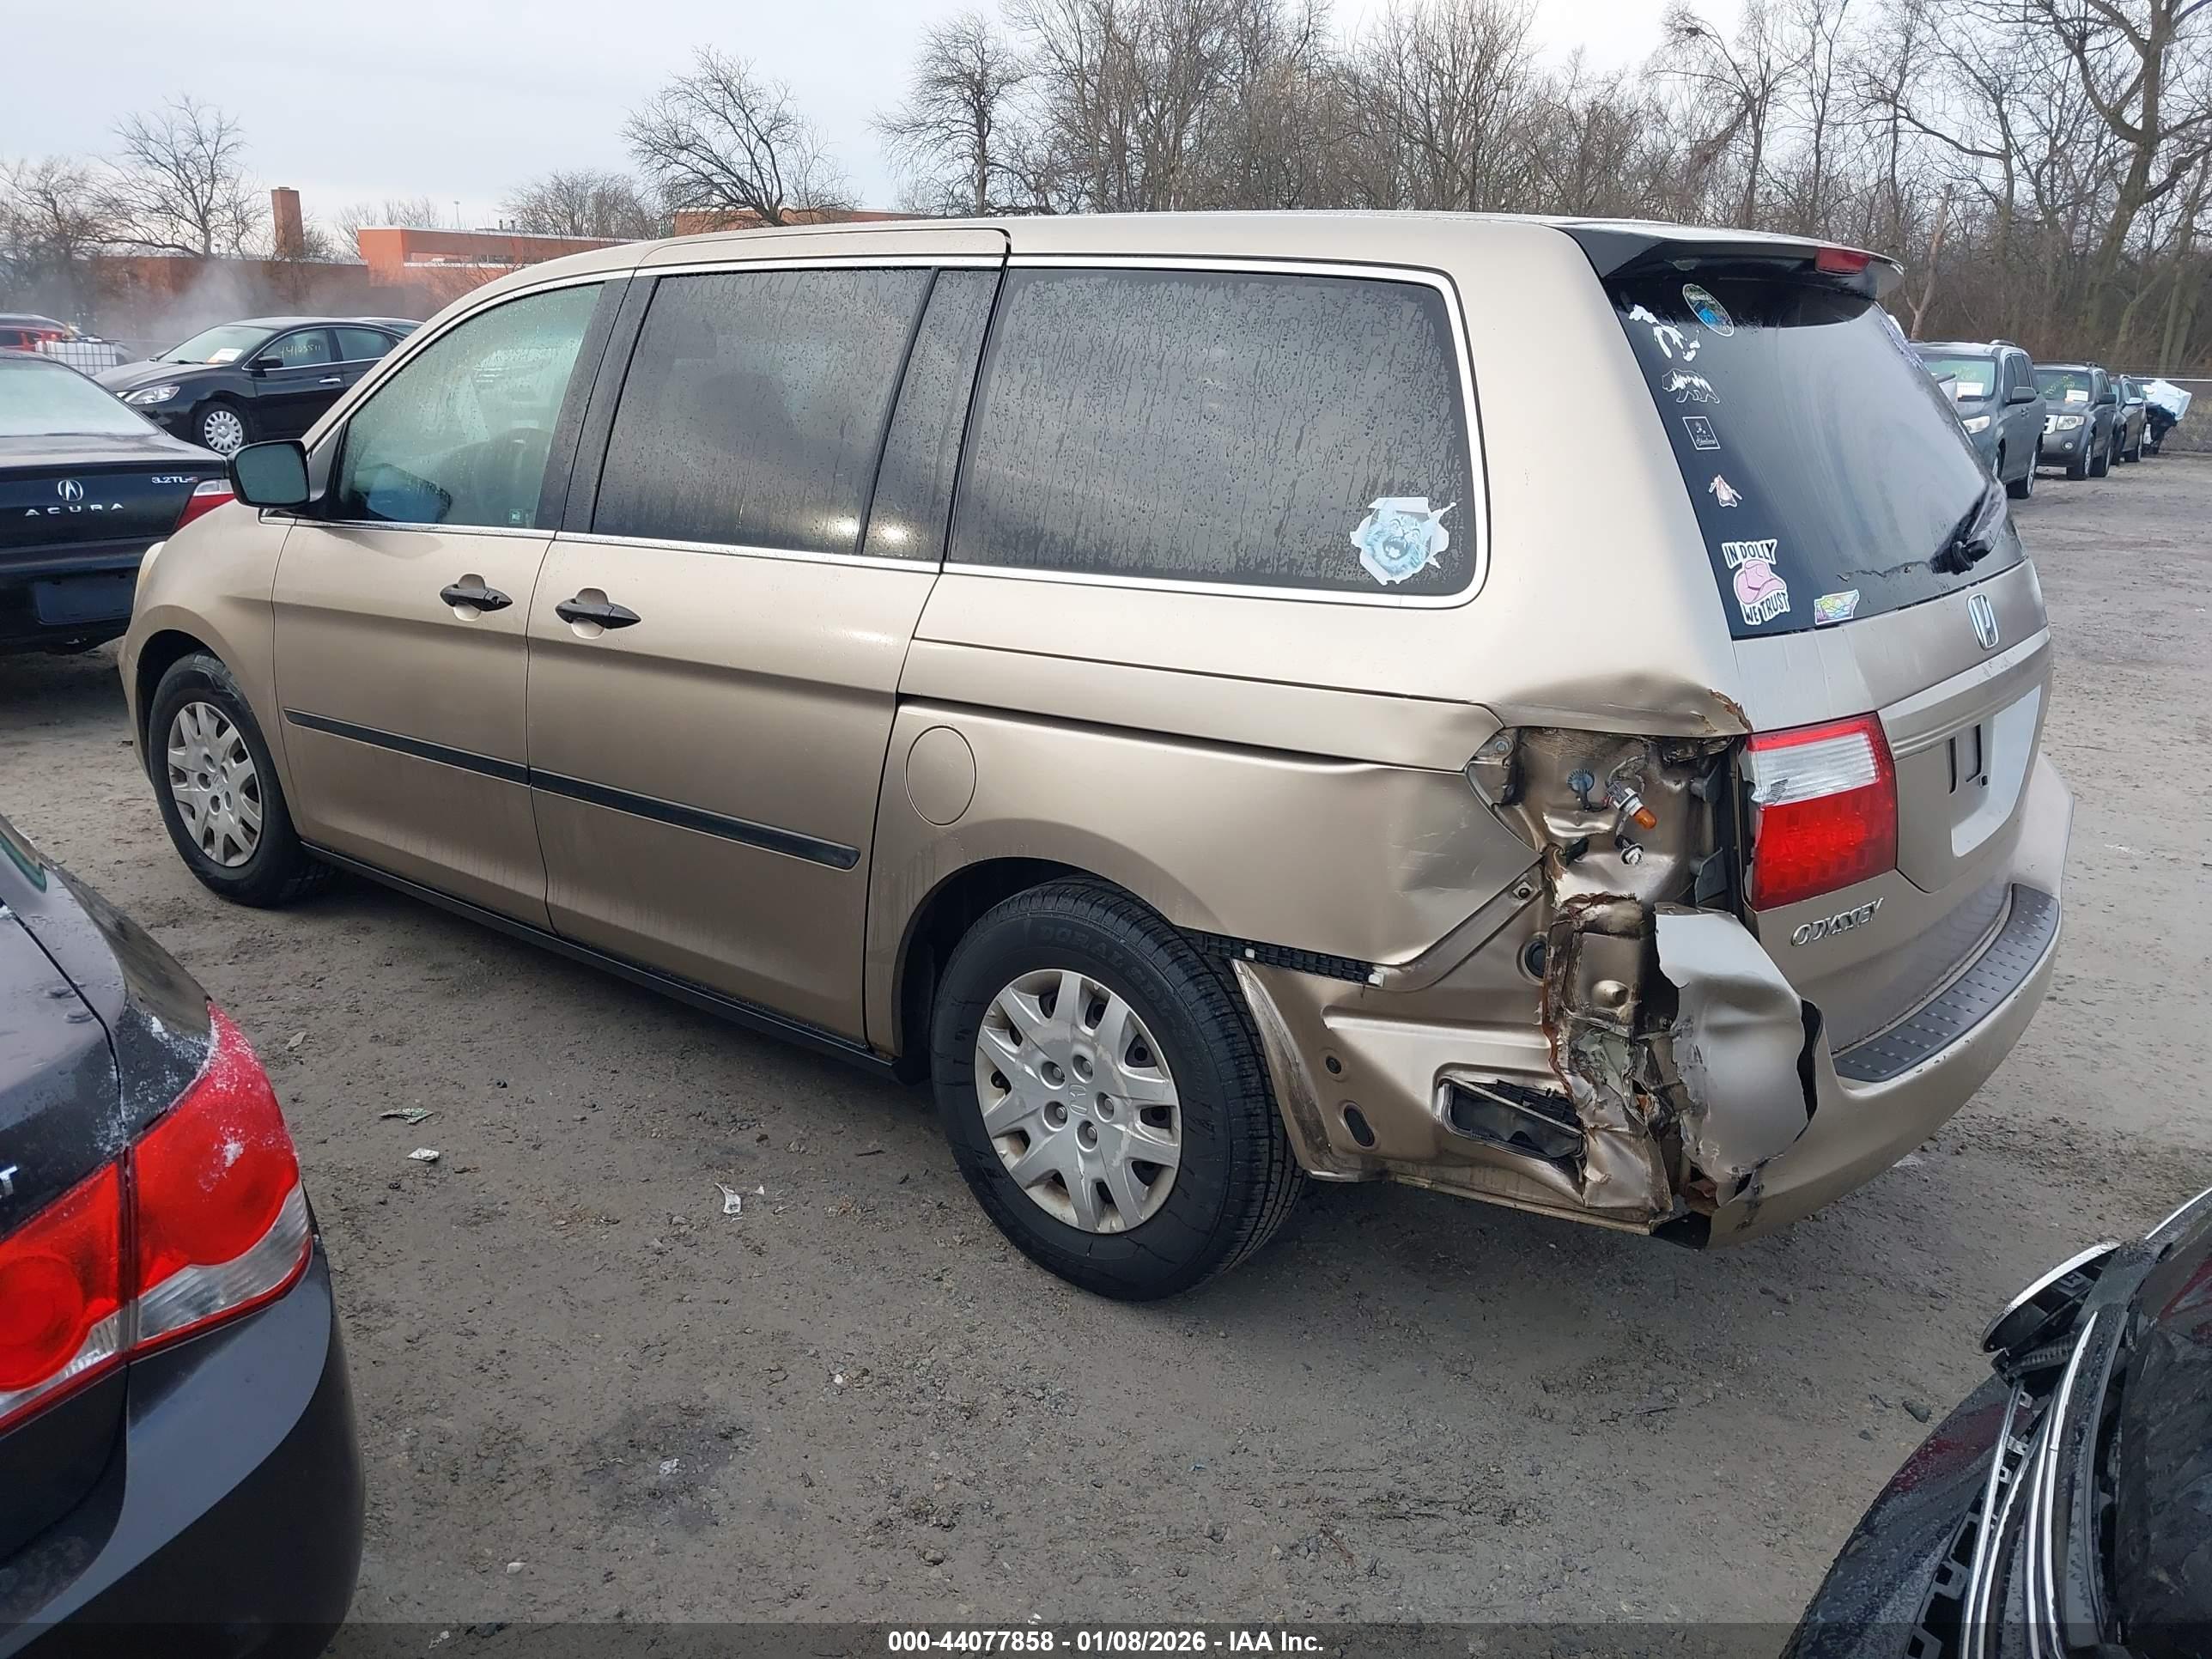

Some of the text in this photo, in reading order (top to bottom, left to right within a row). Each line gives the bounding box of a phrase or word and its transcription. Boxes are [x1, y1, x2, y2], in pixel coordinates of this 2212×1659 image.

[25, 502, 125, 517] ACURA
[1723, 541, 1776, 566] IN DOLLY
[1741, 591, 1789, 623] WE TRUST
[1790, 896, 1885, 946] ODYSSEY
